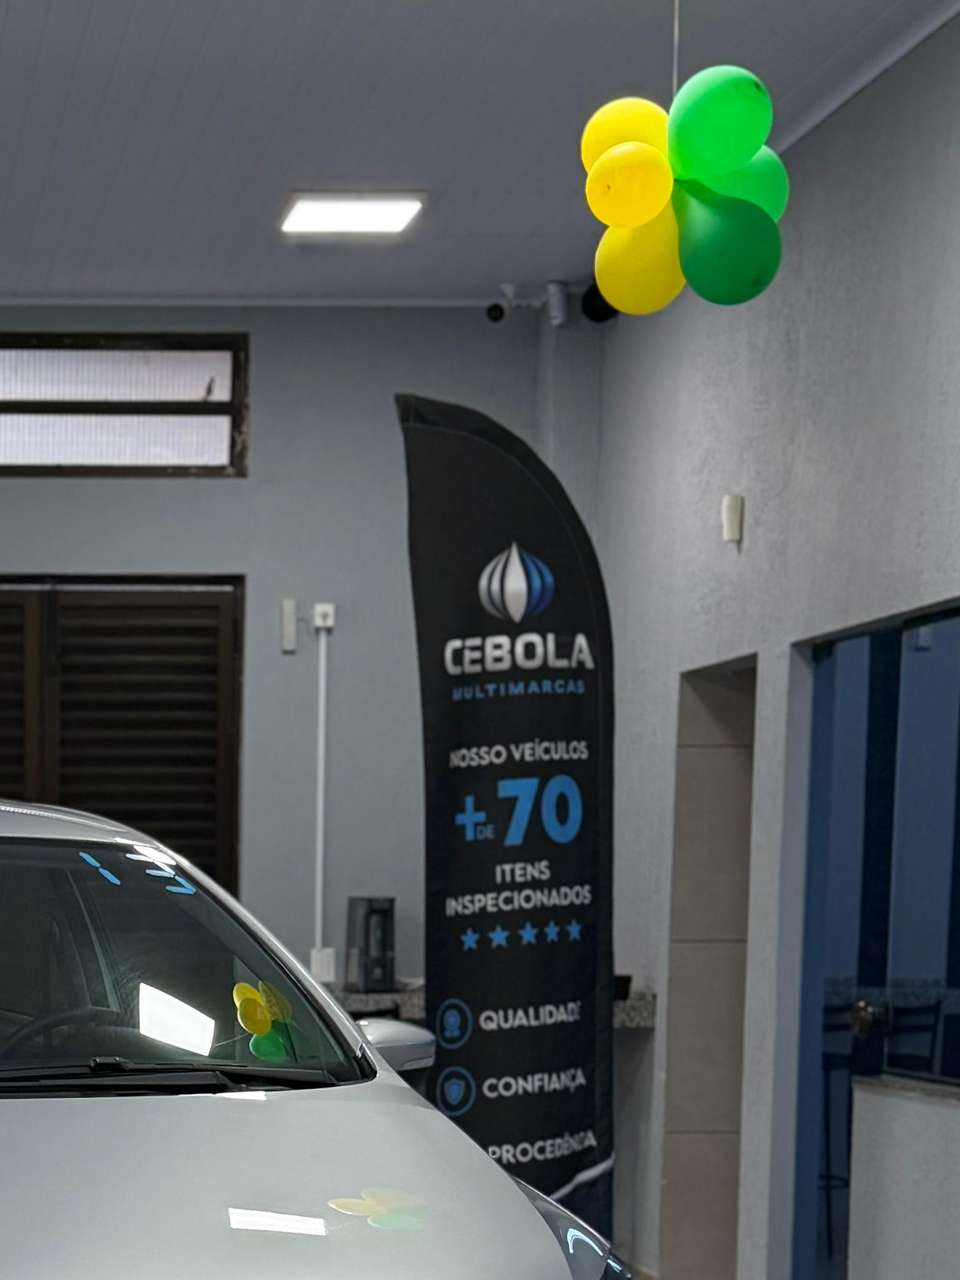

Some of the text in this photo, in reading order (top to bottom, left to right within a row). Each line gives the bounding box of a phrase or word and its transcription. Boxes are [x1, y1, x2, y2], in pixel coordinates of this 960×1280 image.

[443, 632, 596, 676] CEBOLA
[451, 679, 585, 701] MULTIMARCAS
[449, 738, 589, 768] NOSSO VEÍCULOS
[495, 861, 551, 885] ITENS
[445, 885, 592, 916] INSPECIONADOS
[482, 1068, 586, 1098] CONFIANÇA
